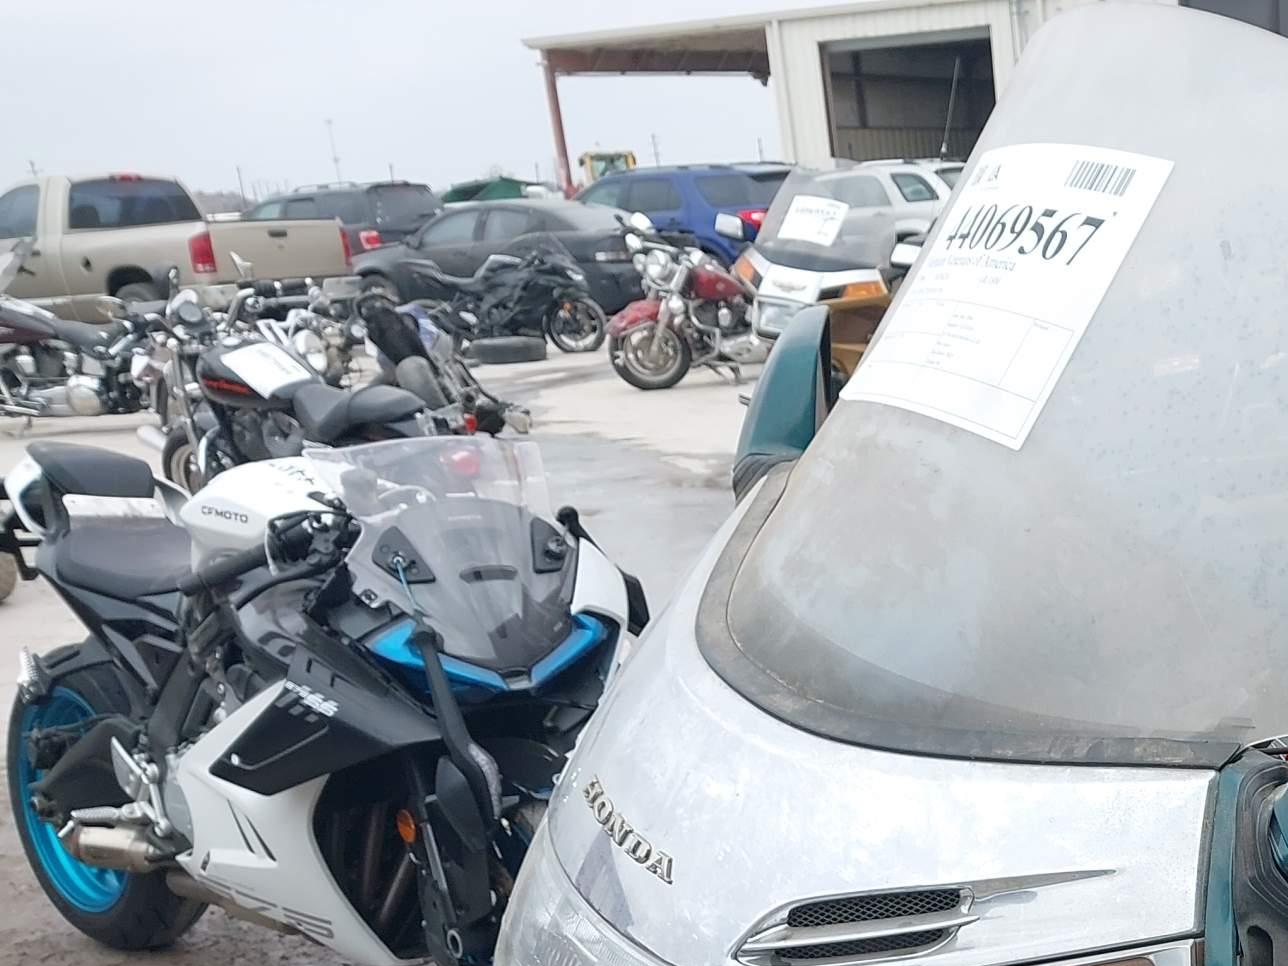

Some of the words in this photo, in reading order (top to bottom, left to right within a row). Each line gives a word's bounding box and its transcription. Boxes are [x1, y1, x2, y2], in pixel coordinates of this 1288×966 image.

[945, 203, 1106, 266] 44069567
[201, 505, 249, 524] CFMOTO
[583, 774, 674, 886] HONDA
